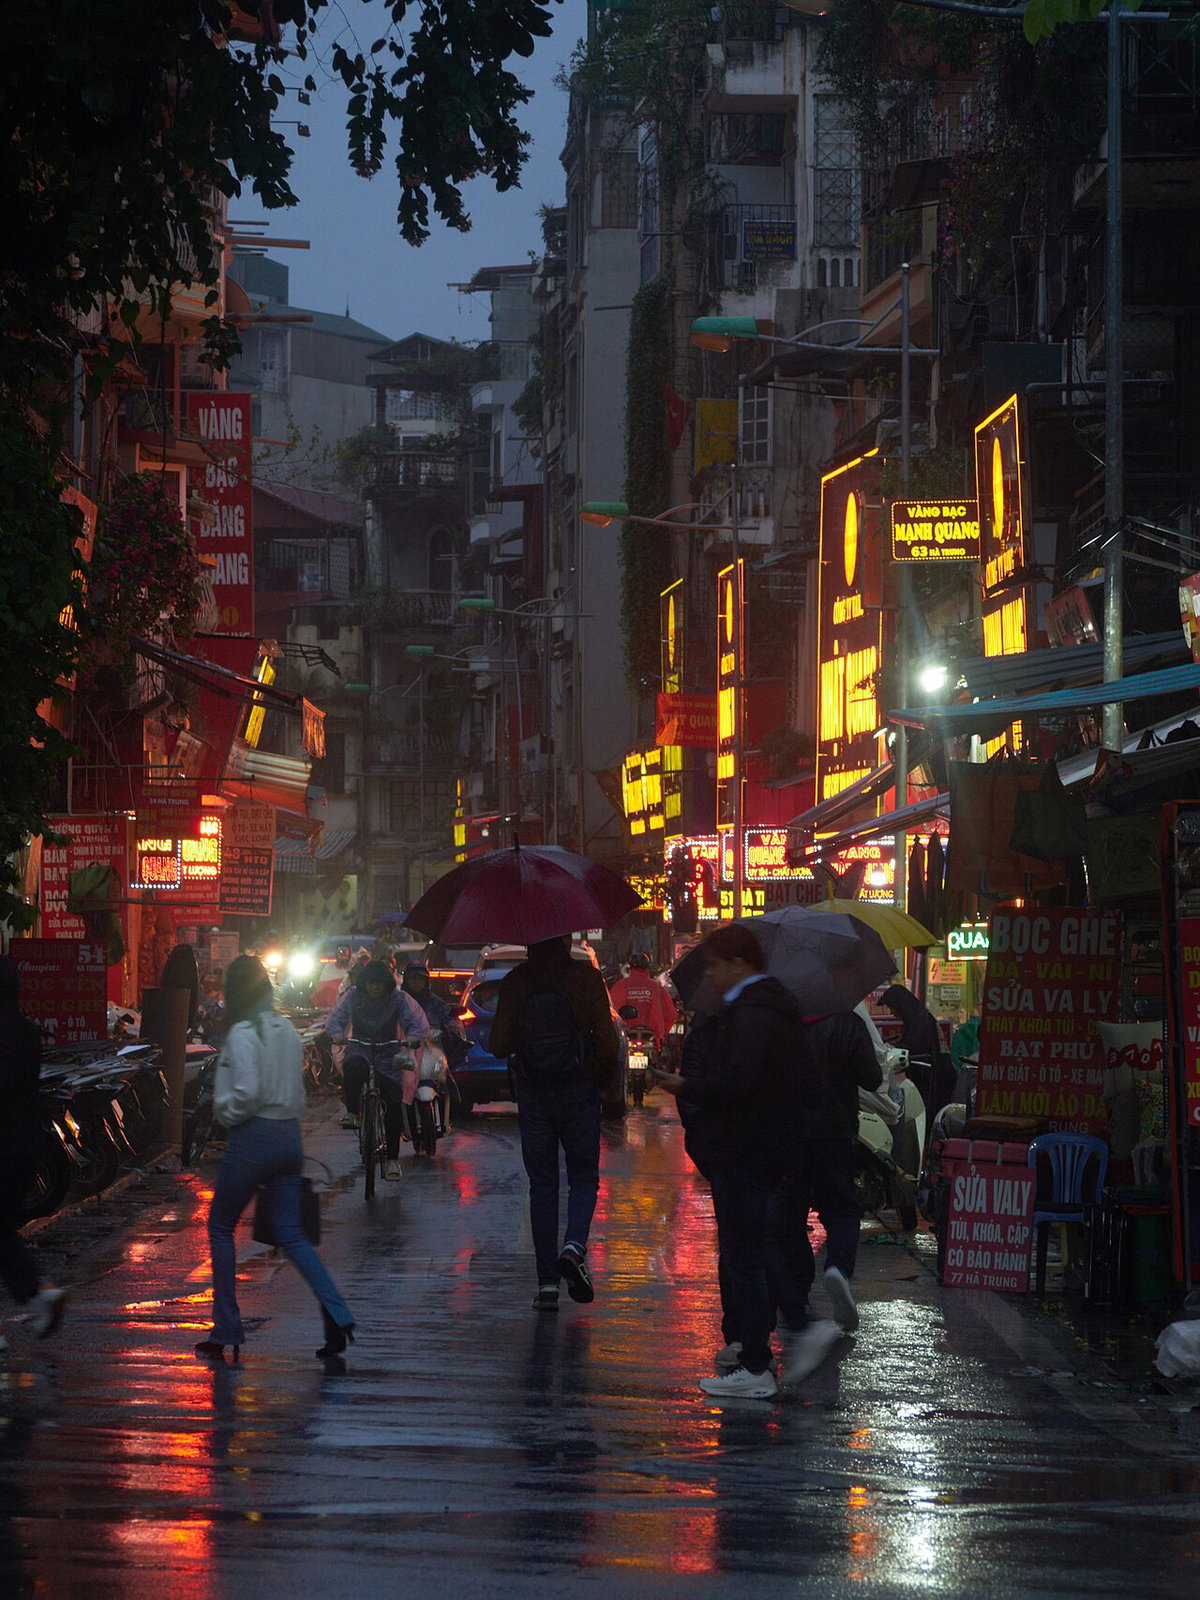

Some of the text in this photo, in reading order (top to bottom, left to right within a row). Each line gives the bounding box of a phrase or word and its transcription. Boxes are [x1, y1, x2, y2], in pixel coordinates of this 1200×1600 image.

[198, 400, 243, 440] VÀNG
[204, 456, 239, 494] BẠC
[907, 505, 968, 519] VÀNG BẠC
[895, 521, 980, 546] MẠNH QUANG
[911, 546, 929, 557] 63
[44, 867, 69, 886] BẠT
[720, 890, 734, 906] 51
[990, 908, 1120, 962] BỌC GHẾ
[77, 943, 105, 964] 54
[989, 961, 1020, 978] DA
[986, 978, 1034, 1012] SỬA
[1043, 988, 1075, 1013] VA
[1083, 989, 1114, 1014] LY
[67, 1031, 79, 1041] XE
[80, 1029, 98, 1042] MÁY
[985, 1015, 1016, 1034] THAY
[1000, 1035, 1096, 1063] BẠT PHỦ
[982, 1062, 1006, 1081] MÁY
[1007, 1063, 1031, 1085] GIẶT
[1039, 1064, 1047, 1083] Ô
[1049, 1064, 1062, 1084] TÔ
[1071, 1067, 1086, 1085] XE
[980, 1083, 1016, 1114] LÀM
[1056, 1087, 1079, 1117] ÁO
[1082, 1093, 1108, 1118] DA
[1048, 1120, 1090, 1134] RUNG
[952, 1164, 1032, 1217] SỬA VALY
[950, 1216, 1030, 1249] TÚI, KHÓA, CẶP
[947, 1244, 1027, 1272] CÓ BẢO HÀNH
[951, 1270, 1018, 1289] 77 HÀ TRUNG
